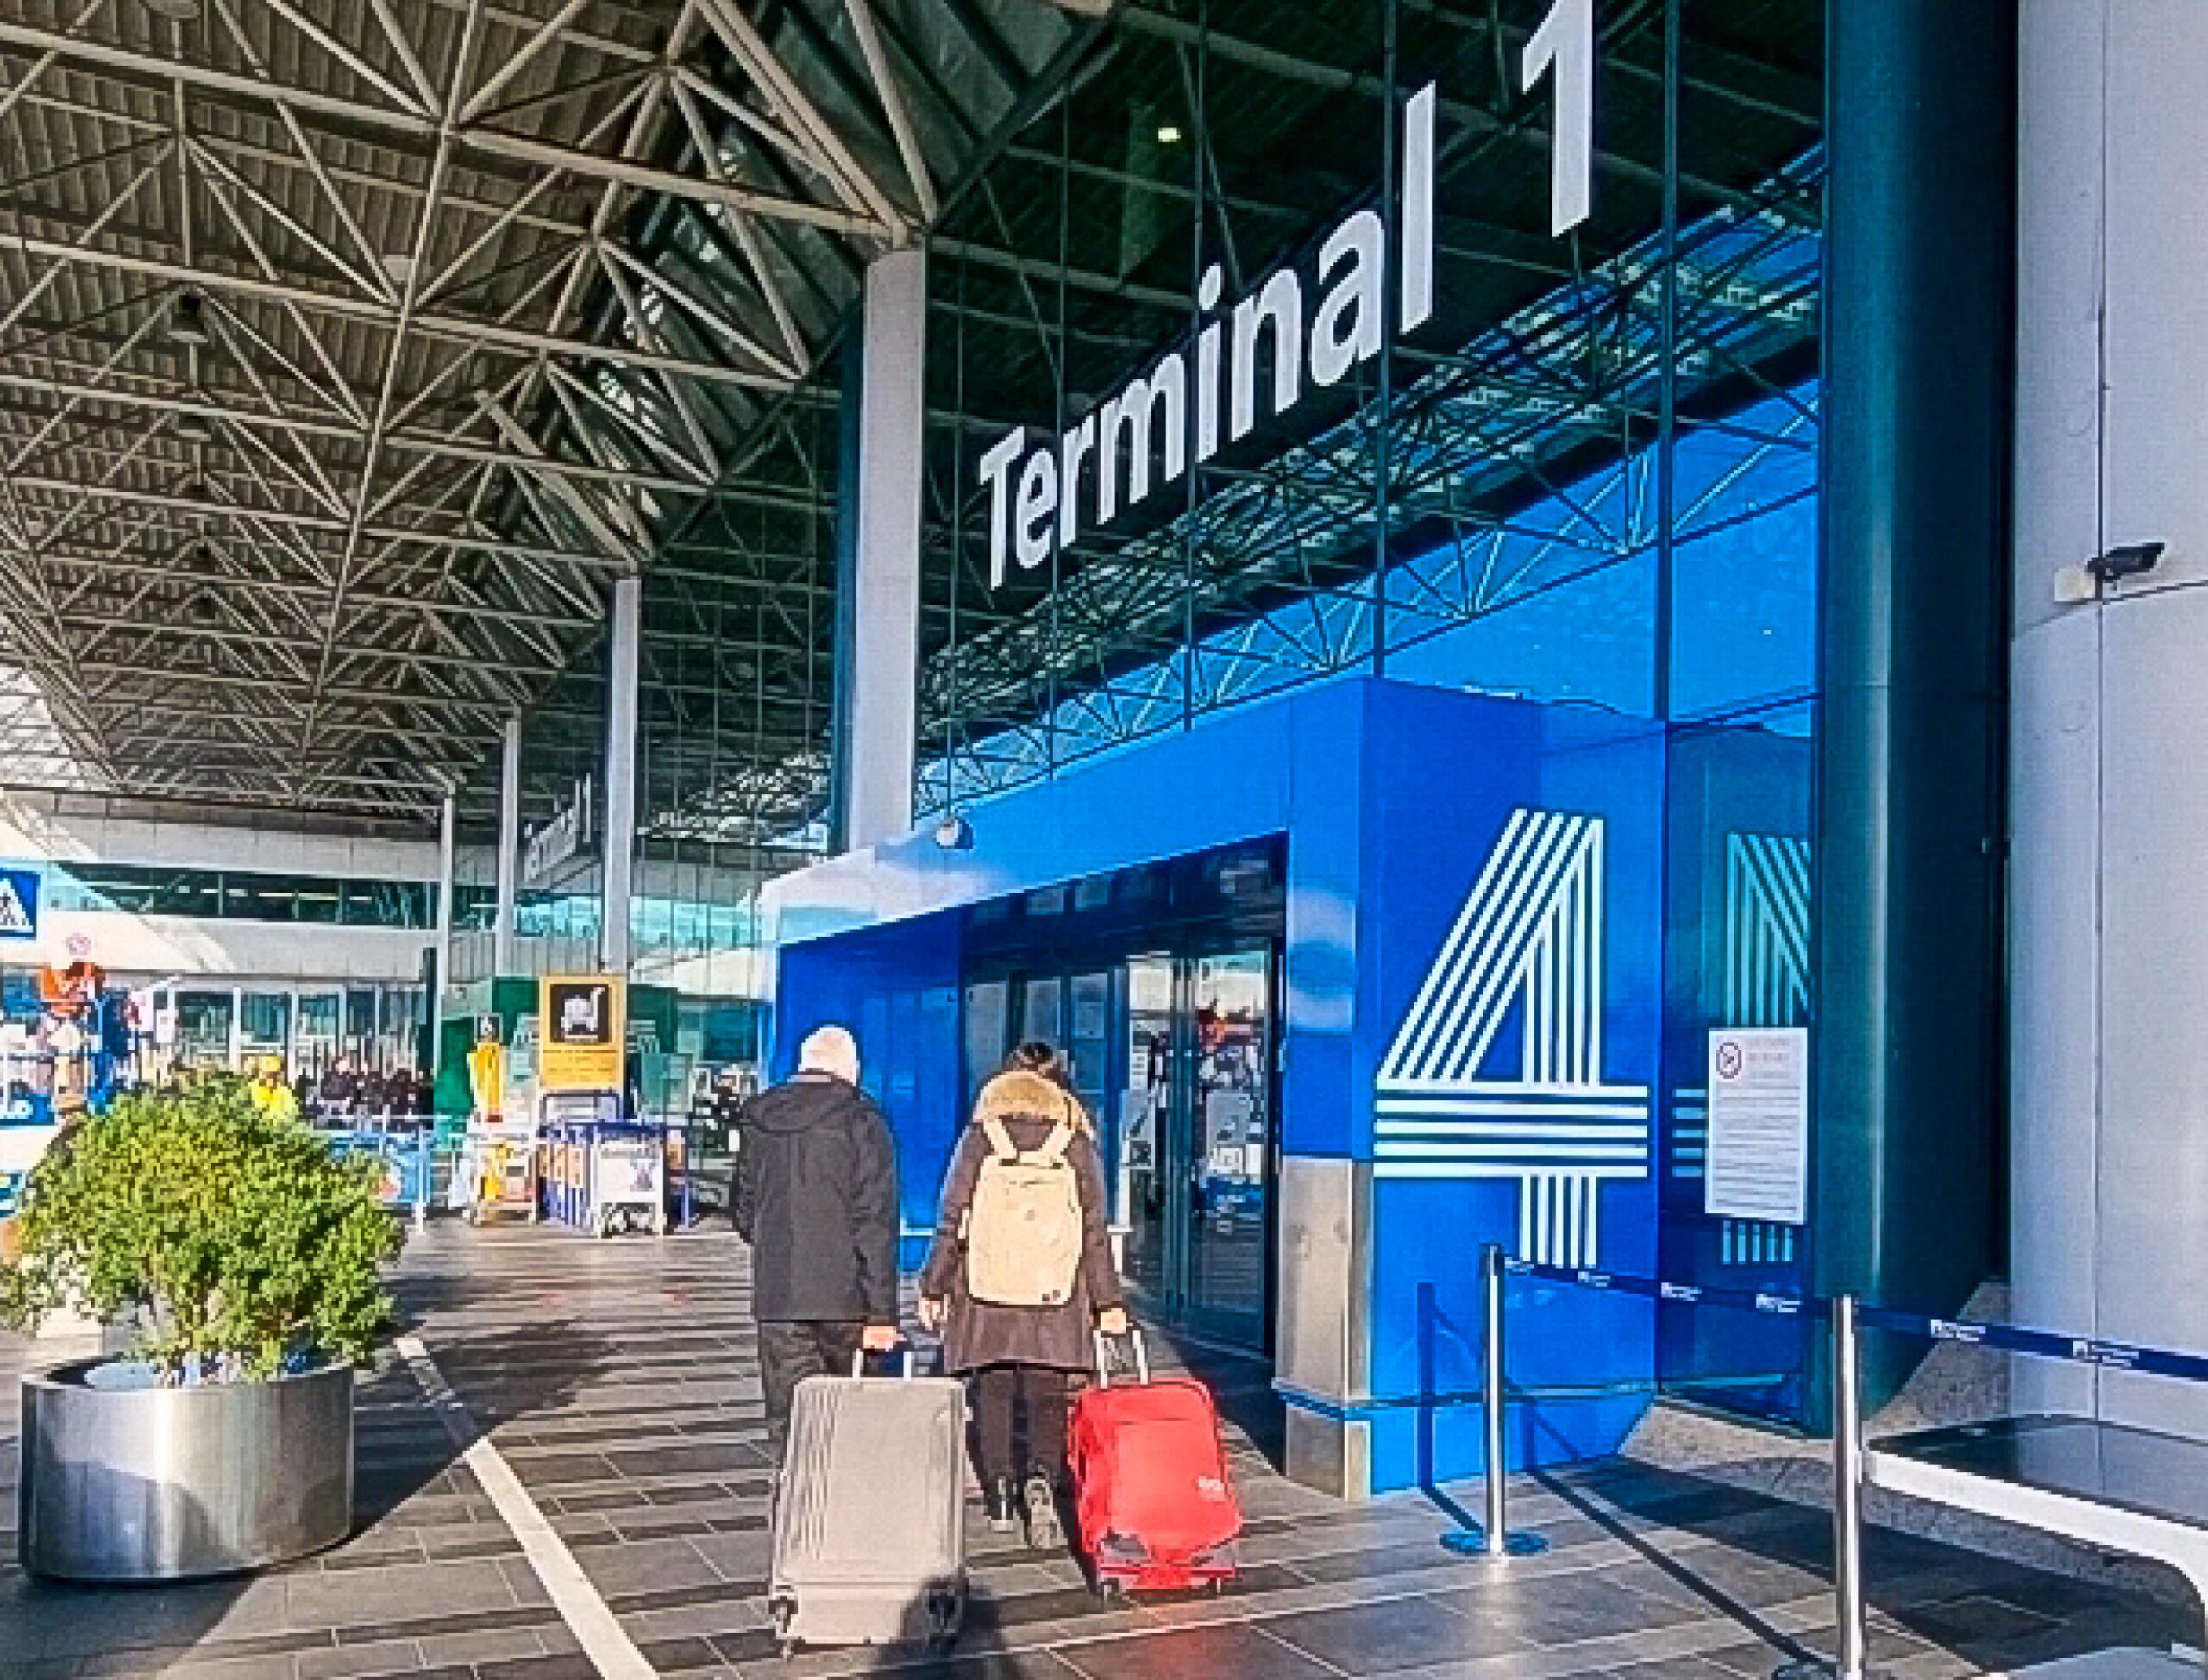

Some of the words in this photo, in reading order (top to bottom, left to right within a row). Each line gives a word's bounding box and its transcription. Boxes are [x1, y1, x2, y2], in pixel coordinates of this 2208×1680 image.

[979, 81, 1437, 592] Terminal
[1521, 0, 1595, 239] 1
[1373, 808, 1649, 1269] 4
